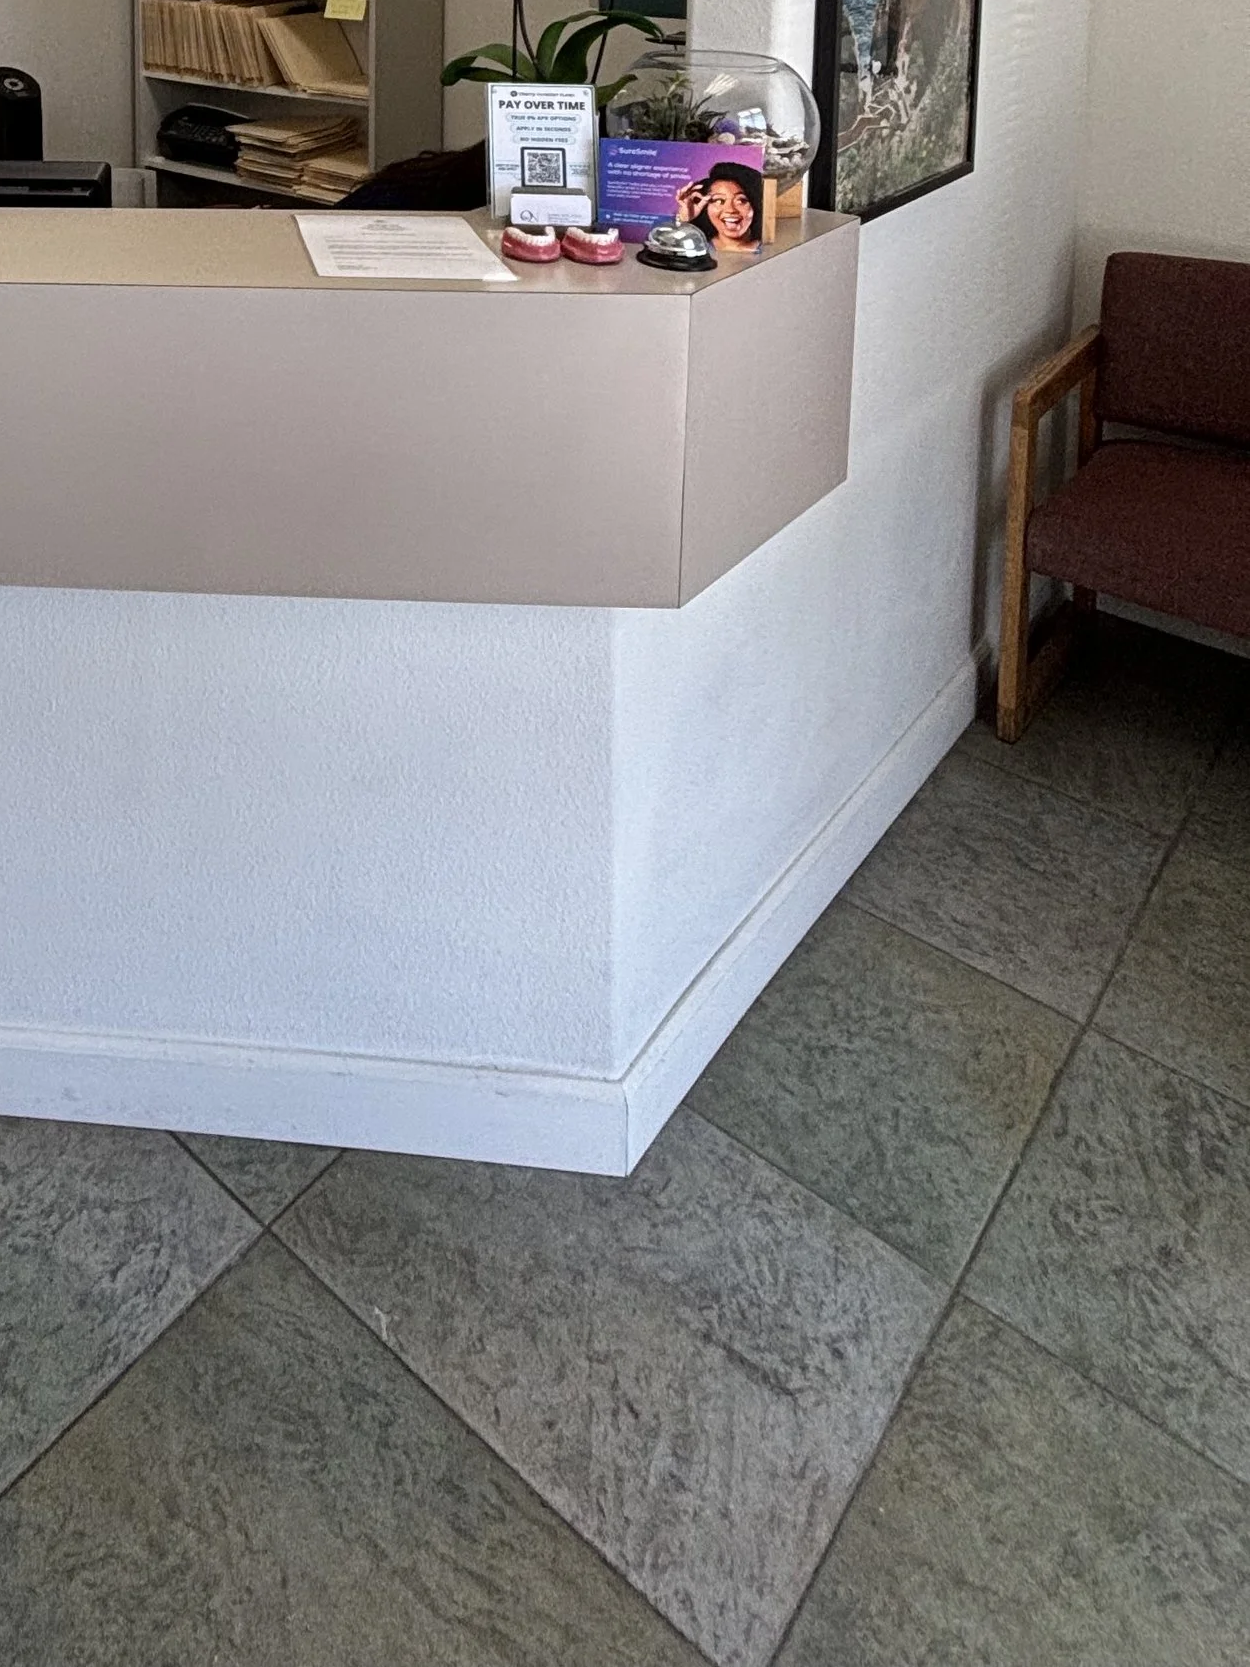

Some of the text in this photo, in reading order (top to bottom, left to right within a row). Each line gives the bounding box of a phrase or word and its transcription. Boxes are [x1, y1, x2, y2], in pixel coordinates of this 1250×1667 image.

[499, 100, 586, 110] PAY OVER TIME
